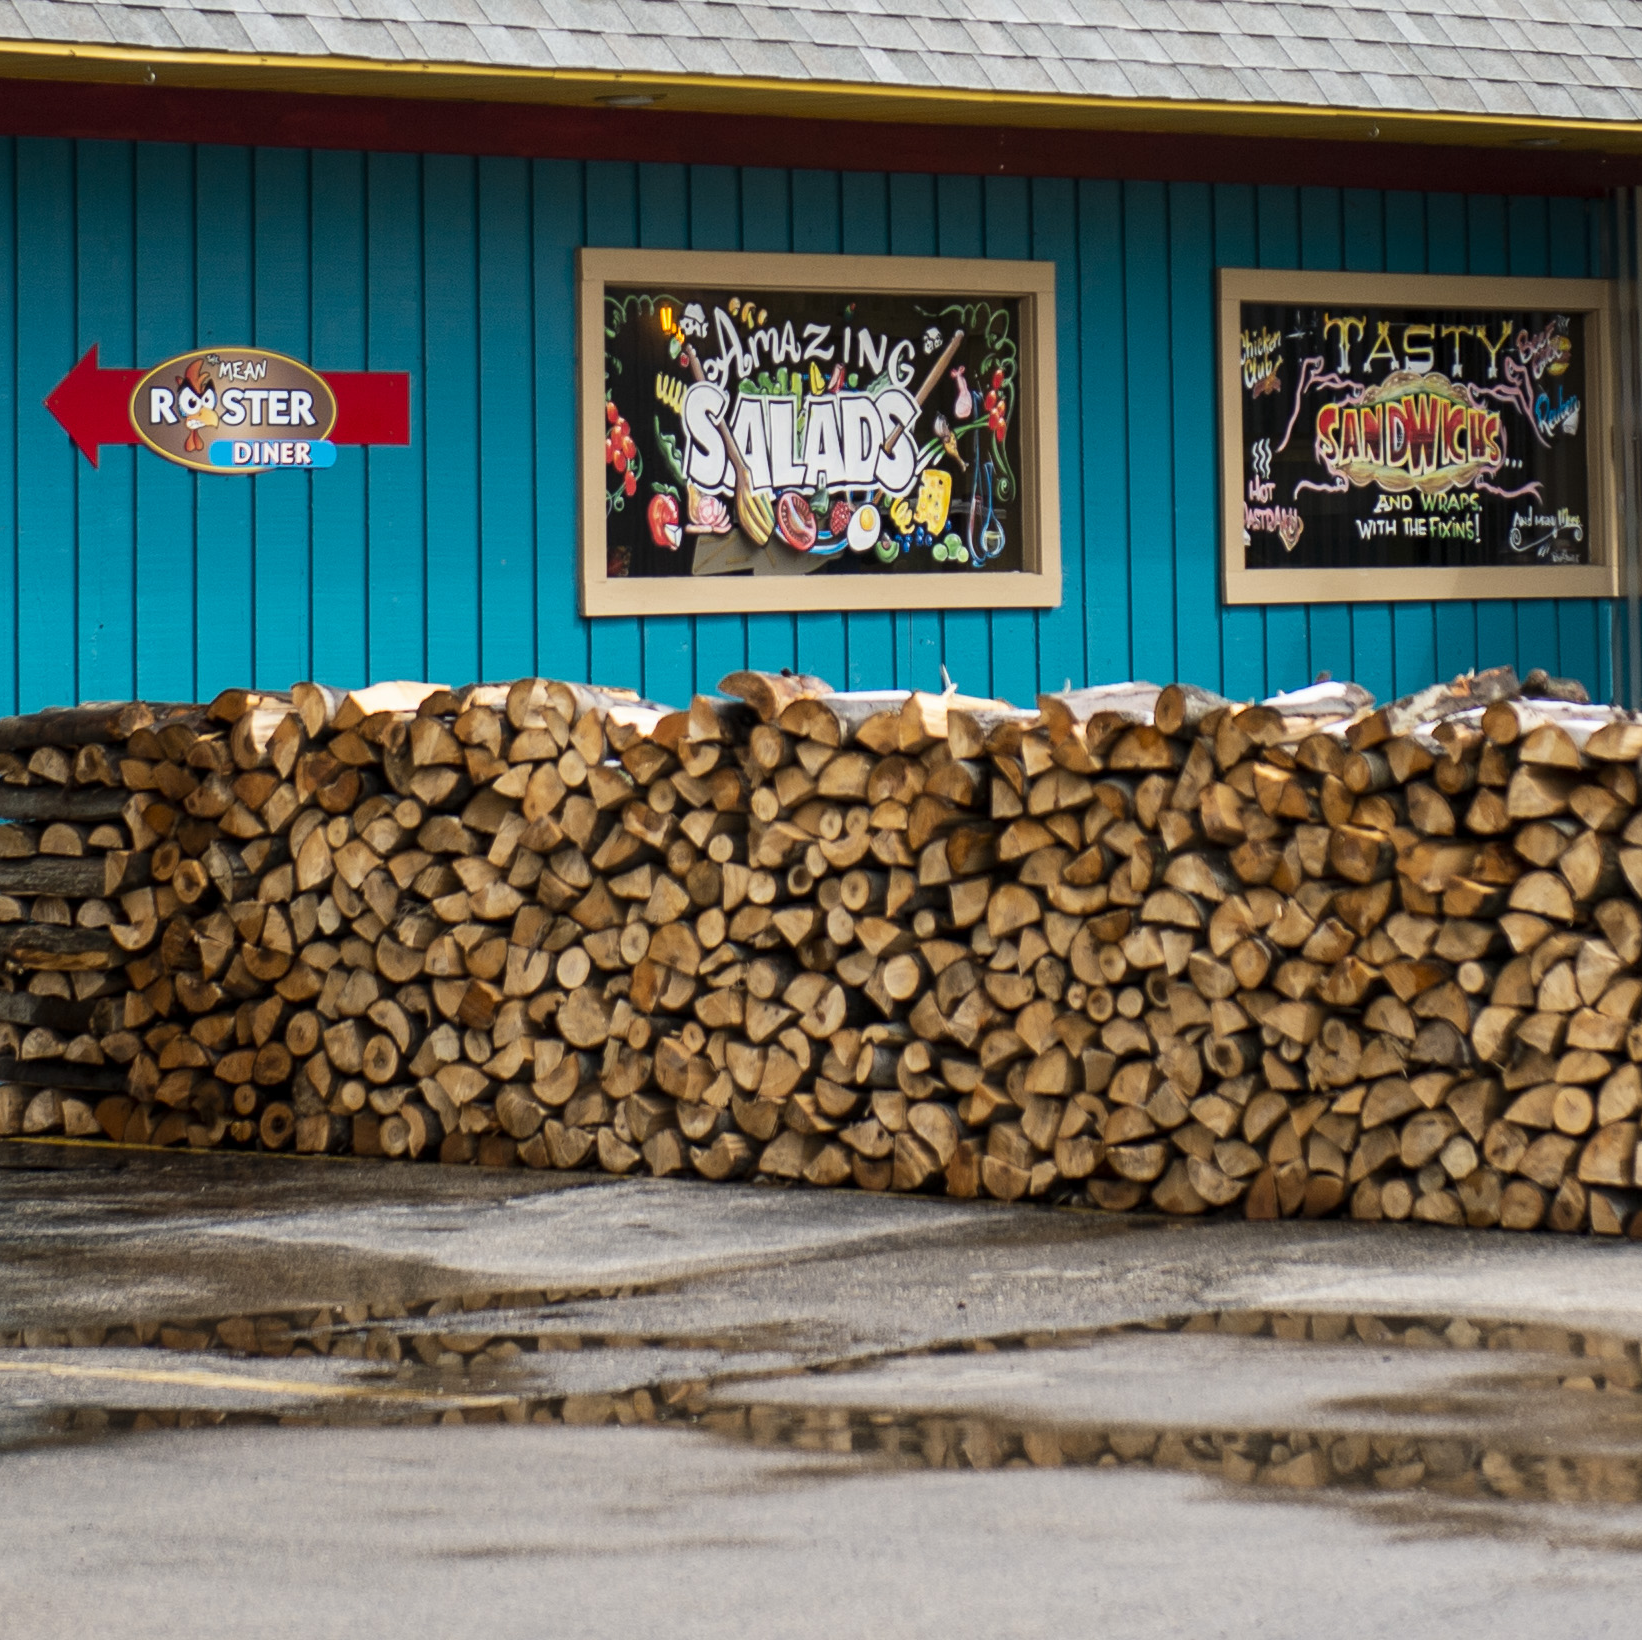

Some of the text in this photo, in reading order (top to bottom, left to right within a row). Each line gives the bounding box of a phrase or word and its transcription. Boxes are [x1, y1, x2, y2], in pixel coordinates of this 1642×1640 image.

[1240, 325, 1282, 357] Chicken
[1324, 313, 1513, 378] TASTY
[217, 359, 267, 382] MEAN
[683, 381, 922, 498] SALADS
[233, 441, 313, 465] DINER
[1373, 494, 1413, 514] AND
[1355, 518, 1397, 540] WITH
[1402, 517, 1427, 536] THE
